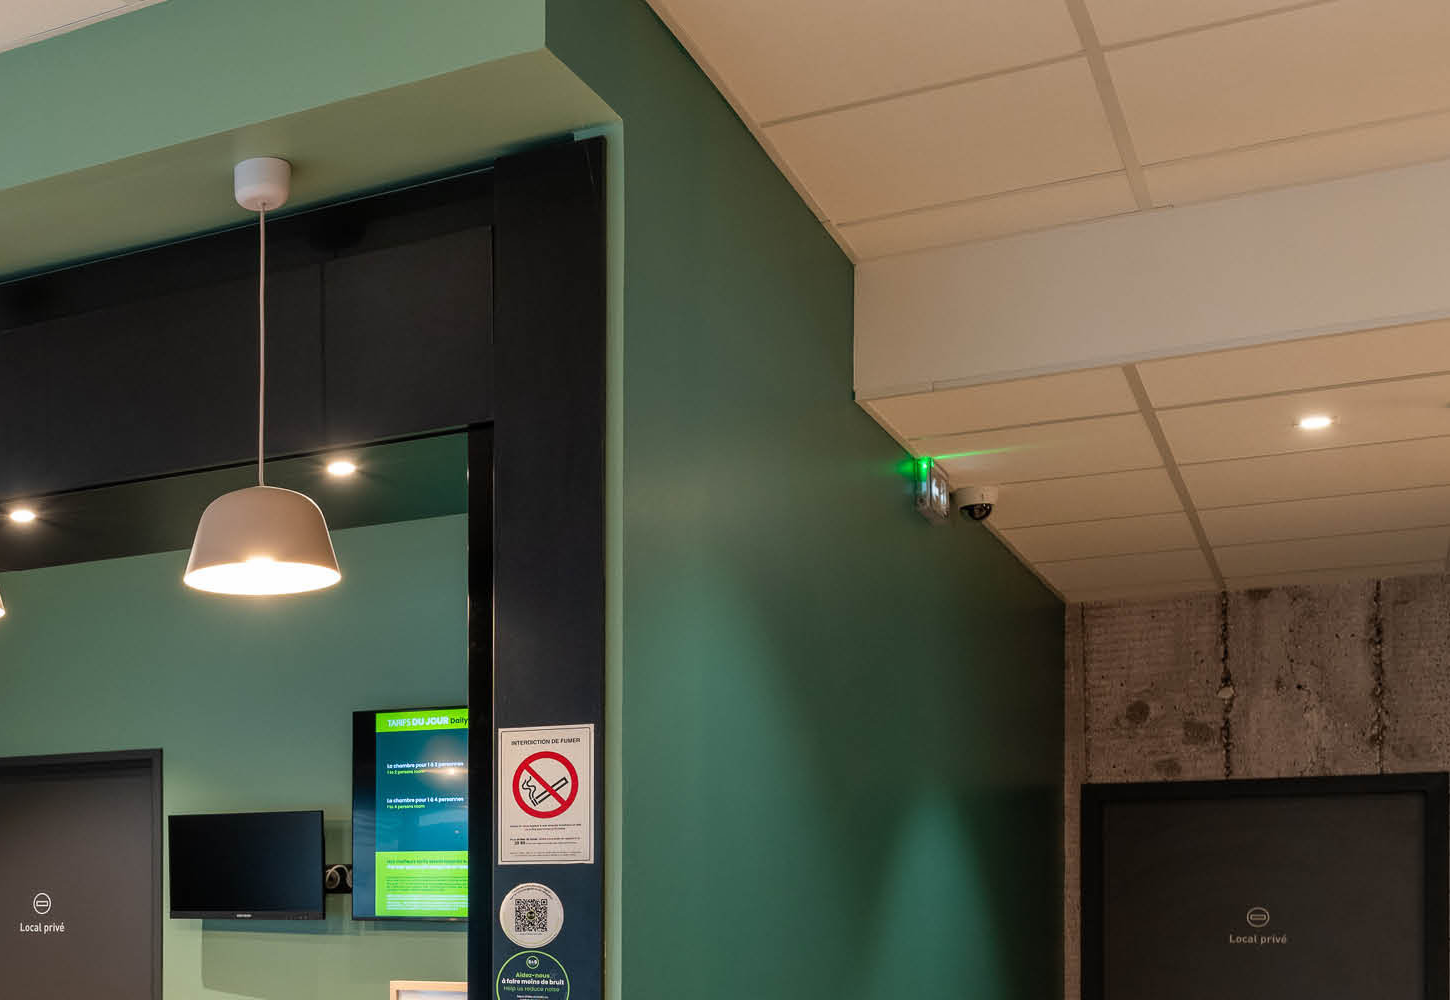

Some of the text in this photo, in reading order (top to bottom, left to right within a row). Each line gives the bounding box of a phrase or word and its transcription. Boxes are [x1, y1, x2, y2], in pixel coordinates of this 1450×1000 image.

[387, 716, 468, 728] TARIFS DU JOUR Daily
[20, 922, 65, 934] Local privé
[1230, 934, 1287, 944] Local privé
